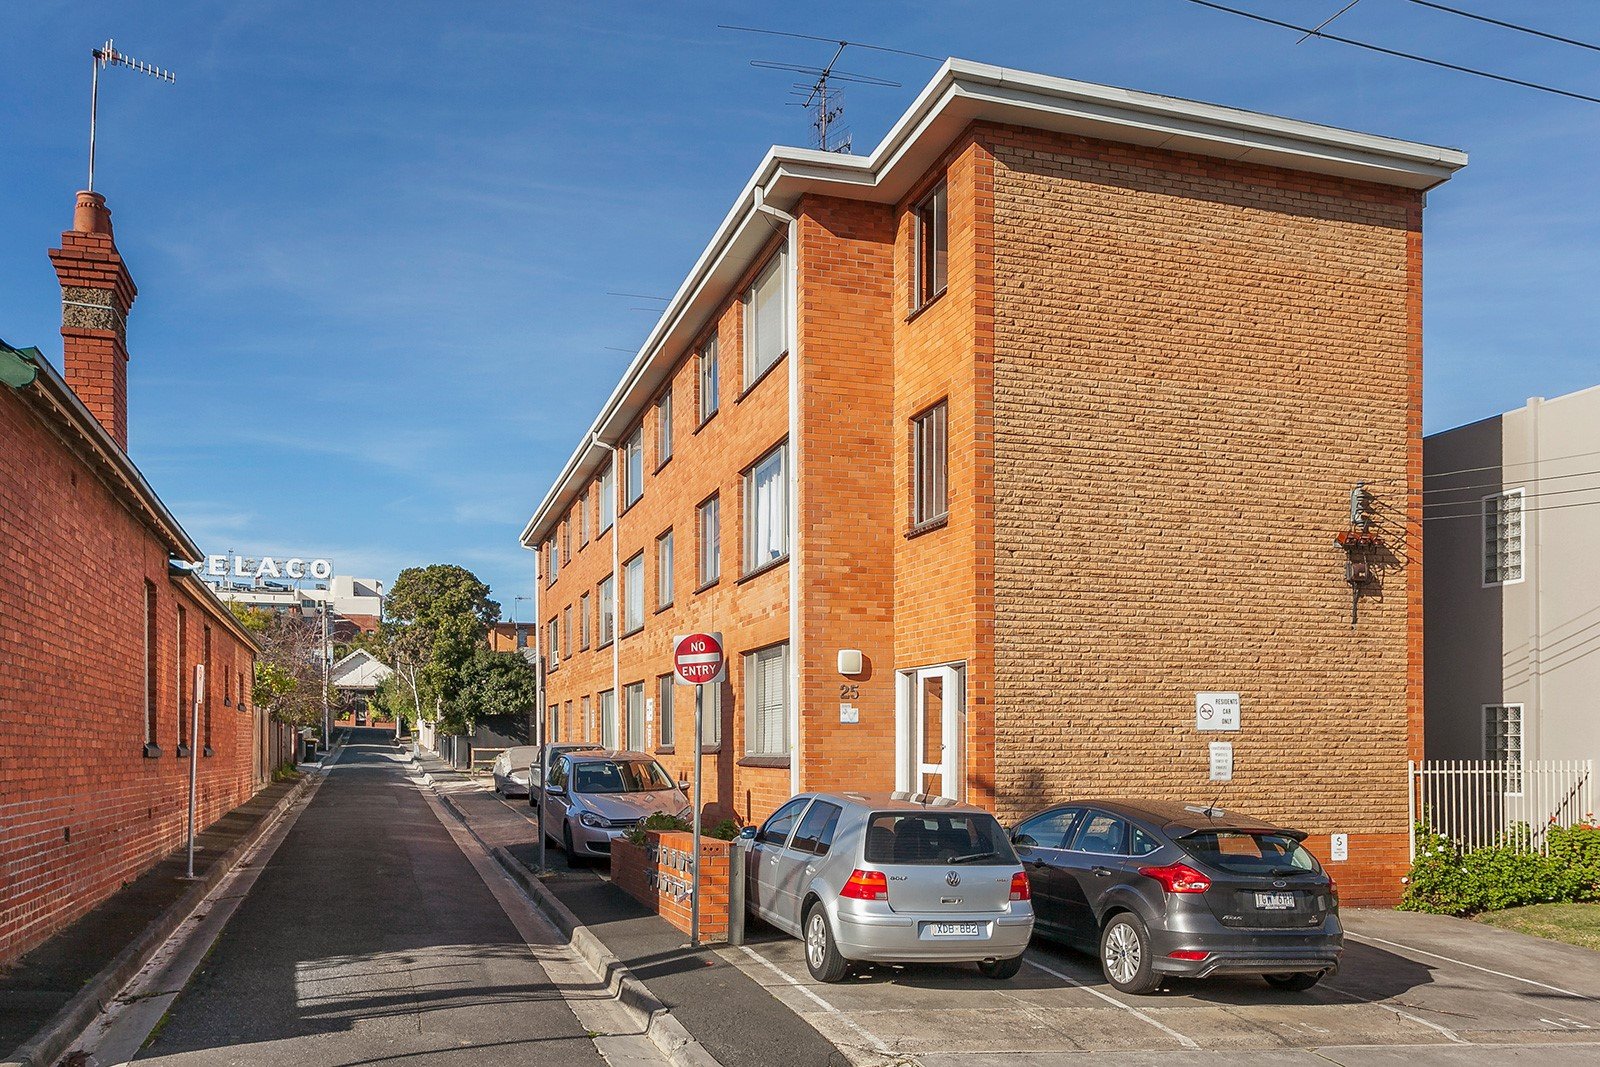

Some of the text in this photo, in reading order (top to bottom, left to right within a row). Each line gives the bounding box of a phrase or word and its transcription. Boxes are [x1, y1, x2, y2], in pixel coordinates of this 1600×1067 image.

[690, 641, 706, 652] NO
[682, 664, 716, 676] ENTRY
[840, 684, 860, 700] 25
